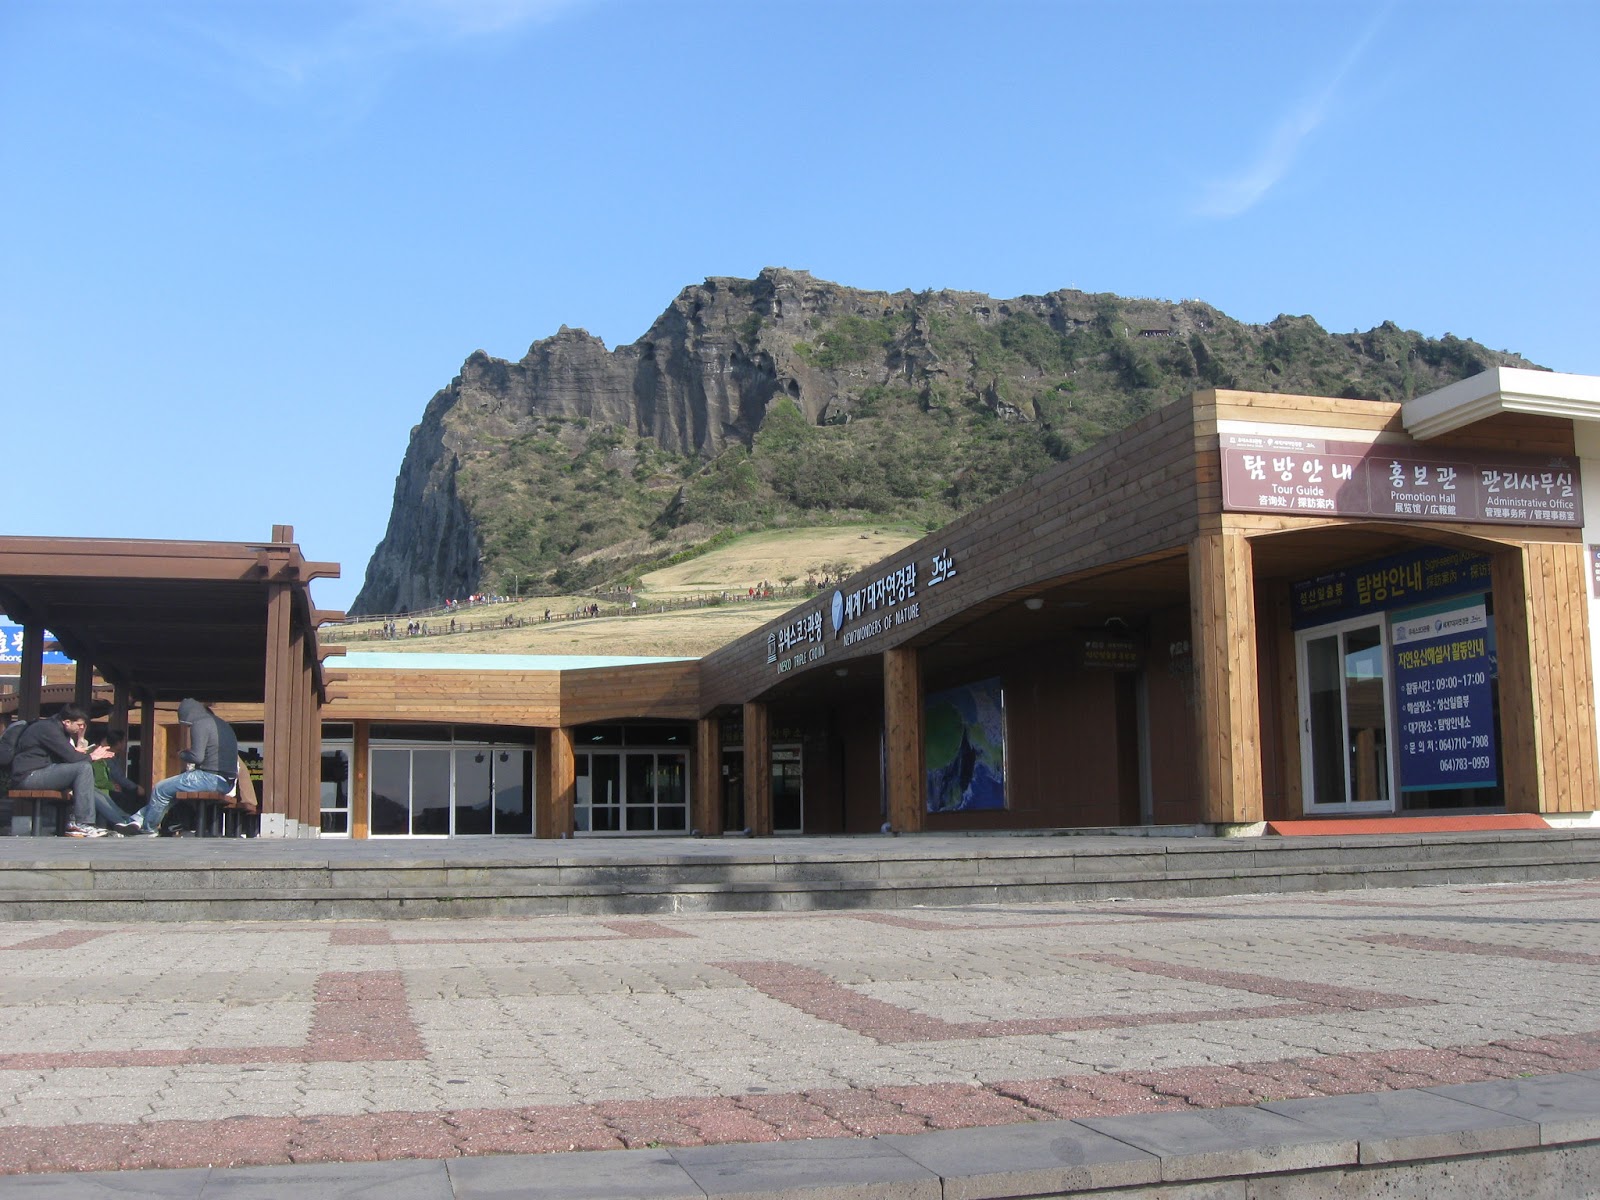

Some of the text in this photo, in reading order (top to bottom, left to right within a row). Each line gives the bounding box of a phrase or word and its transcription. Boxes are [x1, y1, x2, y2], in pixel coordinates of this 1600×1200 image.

[1243, 454, 1353, 481] 탐방안내
[1389, 461, 1457, 490] 홍보관
[1272, 484, 1324, 496] Tour Guide
[1482, 470, 1574, 497] 관리사무실
[1390, 491, 1456, 503] Promotion Hall
[1487, 496, 1574, 510] Administrative Office
[930, 547, 955, 583] Jeju
[1356, 561, 1422, 604] 탐방안내
[778, 562, 917, 652] 유네스코3관왕 세계7대자연경관
[843, 603, 920, 647] NEW7WONDERS OF NATURE
[1398, 638, 1485, 669] 자연유산해설사 활동안내
[1436, 672, 1485, 690] 09:00~17:00
[1437, 695, 1470, 711] 성산일출봉
[1438, 716, 1471, 731] 탐방안내소
[1439, 735, 1489, 751] 064)710-7908
[1440, 756, 1490, 771] 064)783-0959
